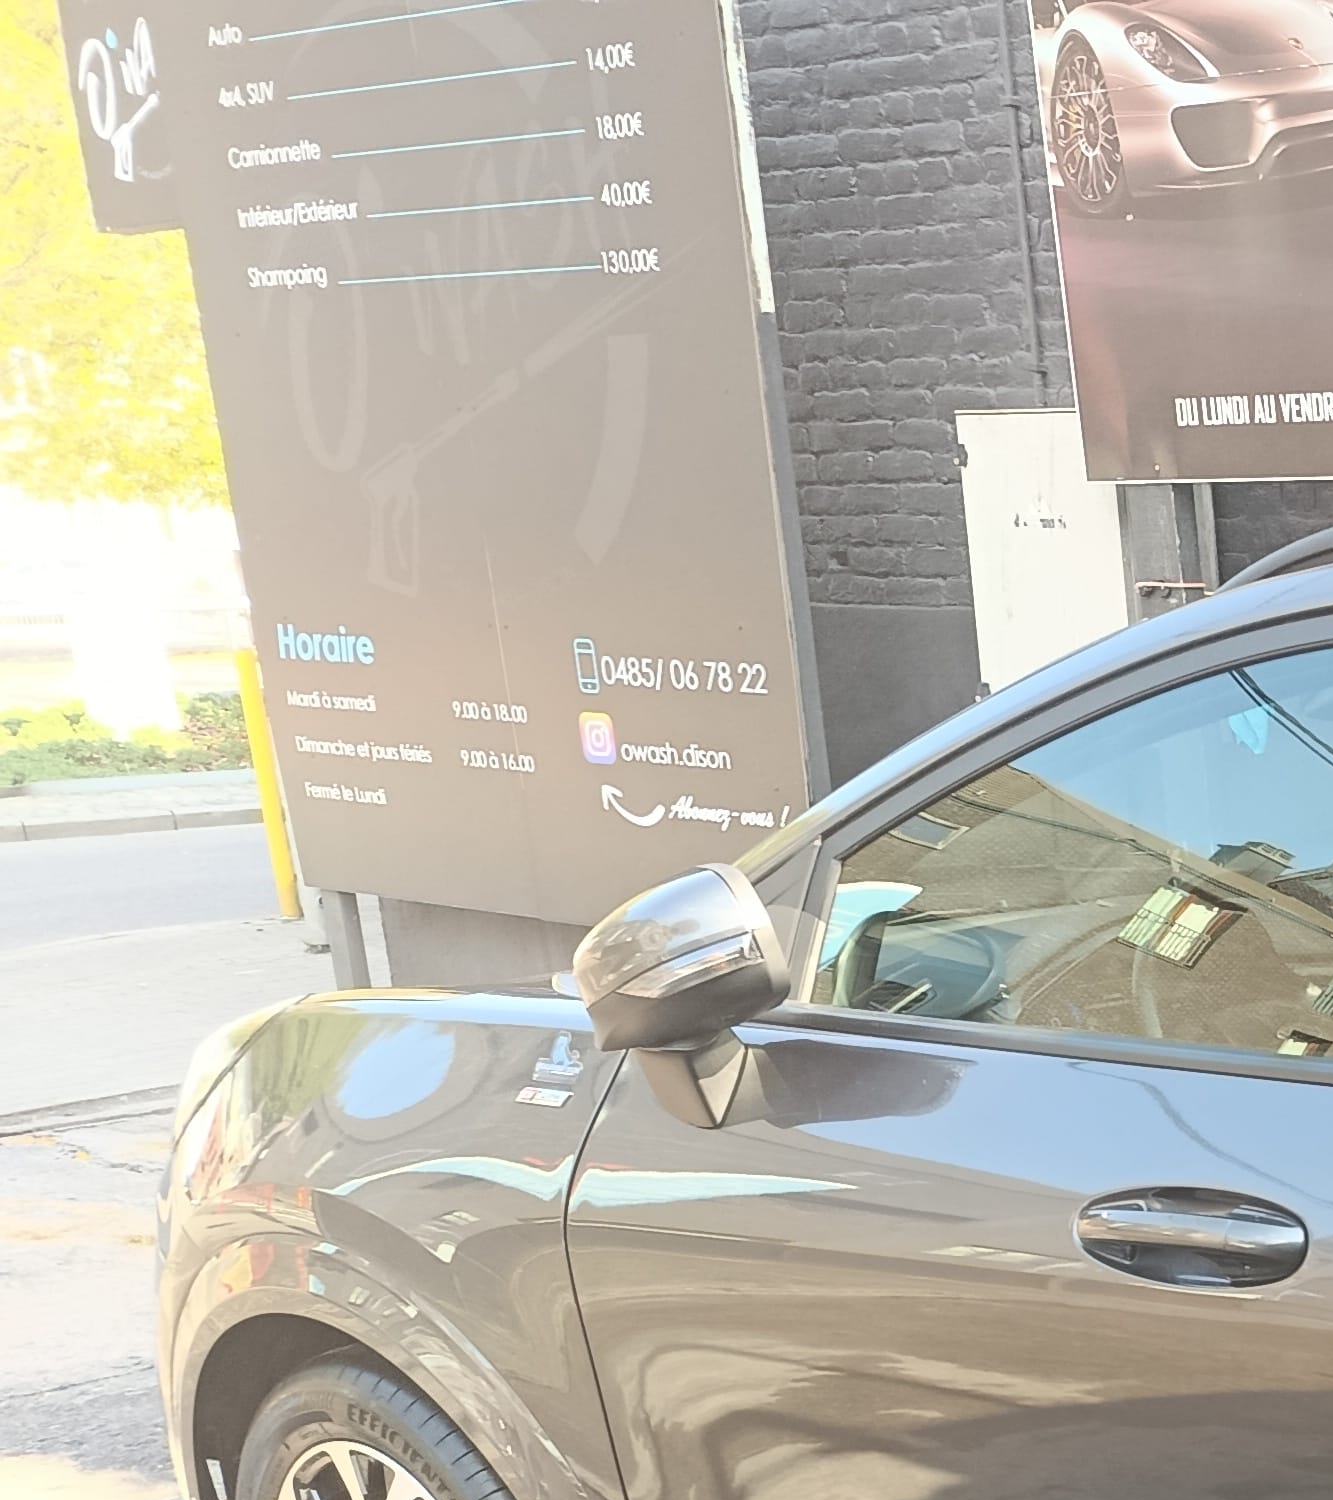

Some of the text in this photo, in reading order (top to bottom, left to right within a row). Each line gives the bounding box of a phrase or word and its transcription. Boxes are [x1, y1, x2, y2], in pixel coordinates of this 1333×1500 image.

[208, 23, 242, 47] Auto
[247, 81, 274, 105] SUV
[586, 42, 636, 73] 14,00€
[228, 112, 645, 169] Camionnette 18,00€
[237, 180, 653, 228] Intérieur/Extérieur 40,00€
[247, 248, 661, 289] Shampoing 130,00€
[1175, 397, 1199, 427] DU
[1201, 395, 1250, 426] LUNDI
[1254, 394, 1276, 424] AU
[276, 623, 375, 664] Horaire
[601, 655, 768, 694] 0485/ 06 78 22
[287, 690, 528, 724] Mardi à samedi 9.00 à 18.00
[295, 735, 535, 773] Dimanche et jours fériés 9.00 à 16.00
[621, 742, 732, 770] owash.dison
[304, 781, 387, 805] Fermé le Lundi
[668, 795, 775, 832] Abonnez-vous
